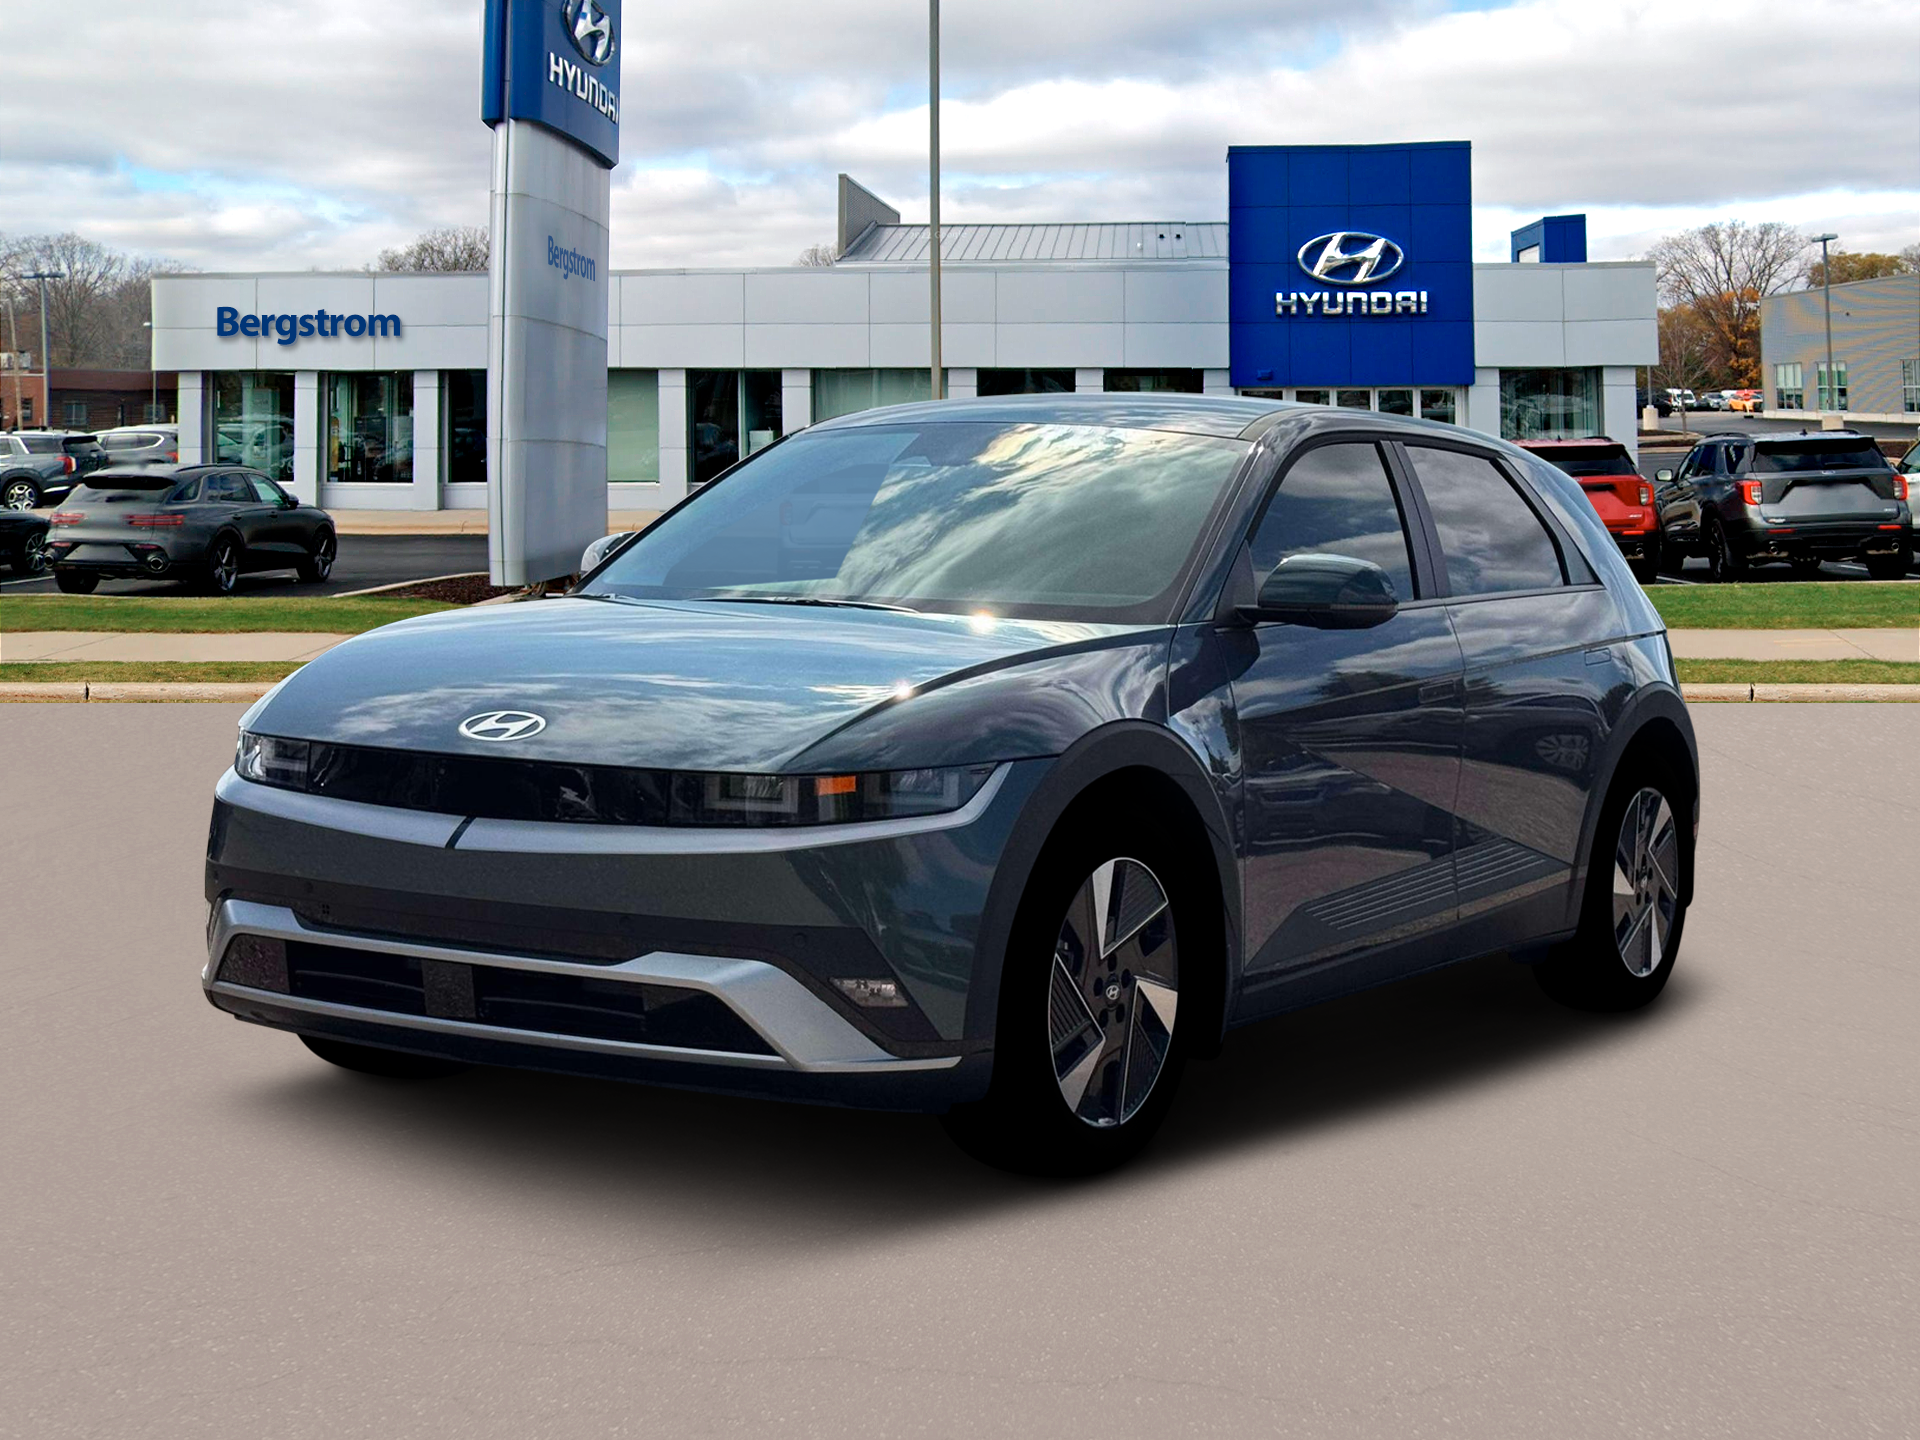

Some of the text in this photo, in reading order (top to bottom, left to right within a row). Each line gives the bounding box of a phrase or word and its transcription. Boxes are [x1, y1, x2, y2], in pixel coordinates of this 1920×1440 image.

[548, 52, 619, 124] HYUNDAI
[547, 235, 596, 282] Bergstrom
[1275, 290, 1428, 315] HYUNDAI
[216, 306, 401, 346] Bergstrom
